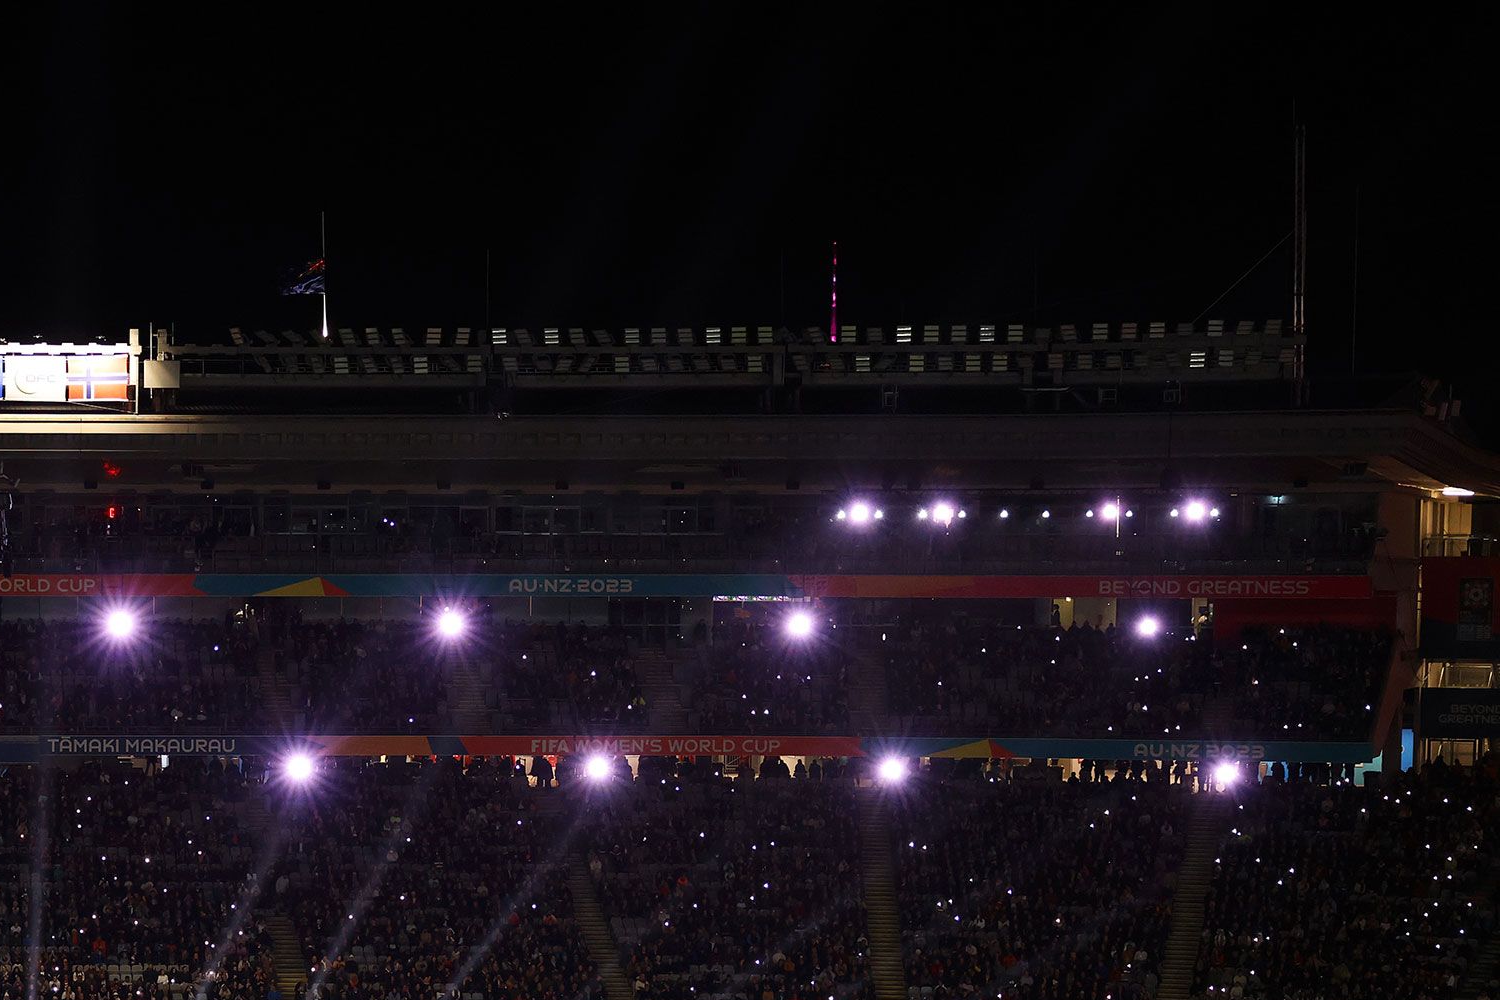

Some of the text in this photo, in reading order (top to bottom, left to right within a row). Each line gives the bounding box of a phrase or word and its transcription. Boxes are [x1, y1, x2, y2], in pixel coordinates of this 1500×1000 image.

[57, 578, 96, 593] CUP
[1098, 580, 1310, 594] BEYOND GREATNESS
[47, 736, 236, 753] TĀMAKI MAKAURAU
[530, 739, 781, 753] FIFA WOMEN'S WORLD CUP
